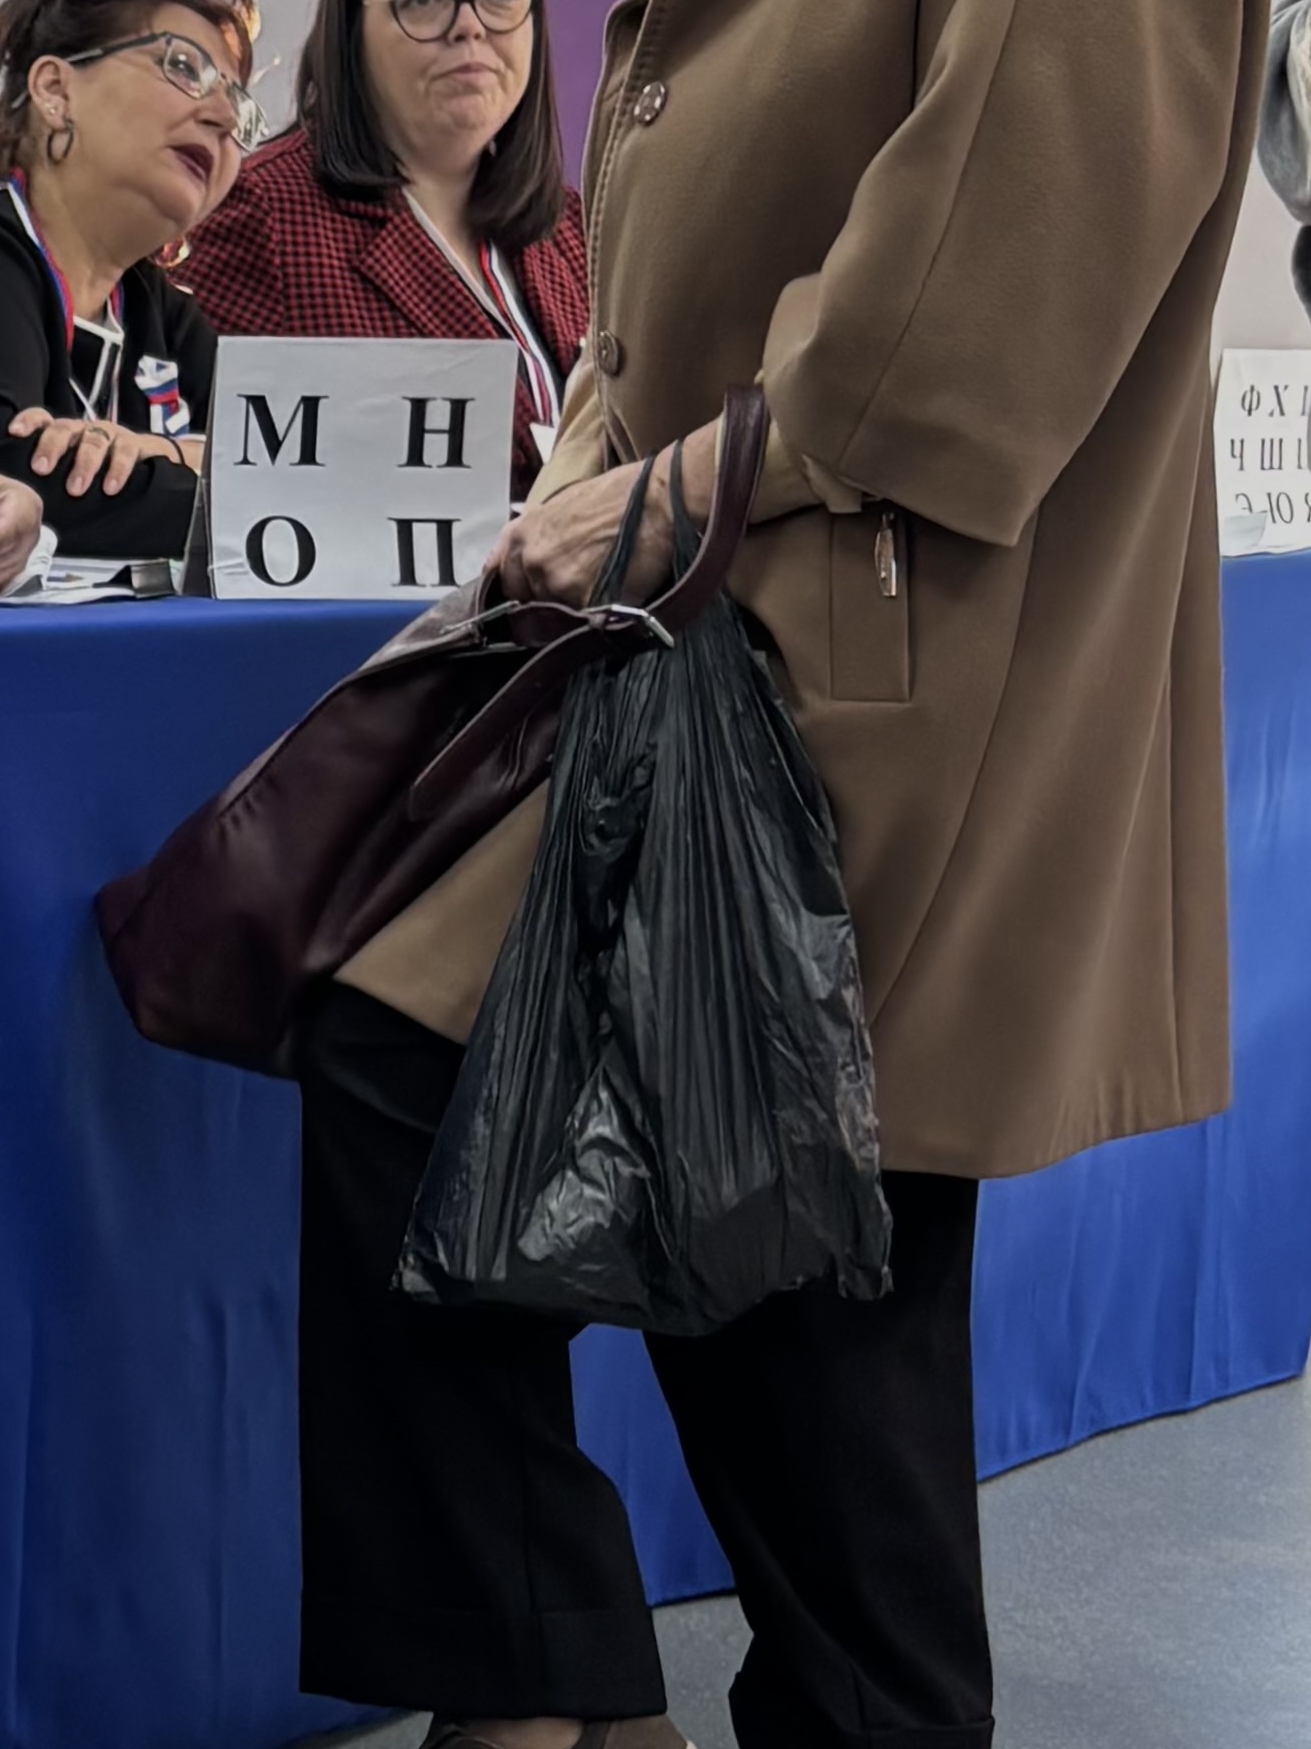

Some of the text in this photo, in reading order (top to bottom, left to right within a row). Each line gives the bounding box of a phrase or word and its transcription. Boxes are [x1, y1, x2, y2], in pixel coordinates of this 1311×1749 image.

[1240, 384, 1261, 417] Ф
[1268, 384, 1289, 417] Х
[234, 393, 475, 469] М Н
[1266, 491, 1294, 525] Ю
[244, 515, 463, 588] О П
